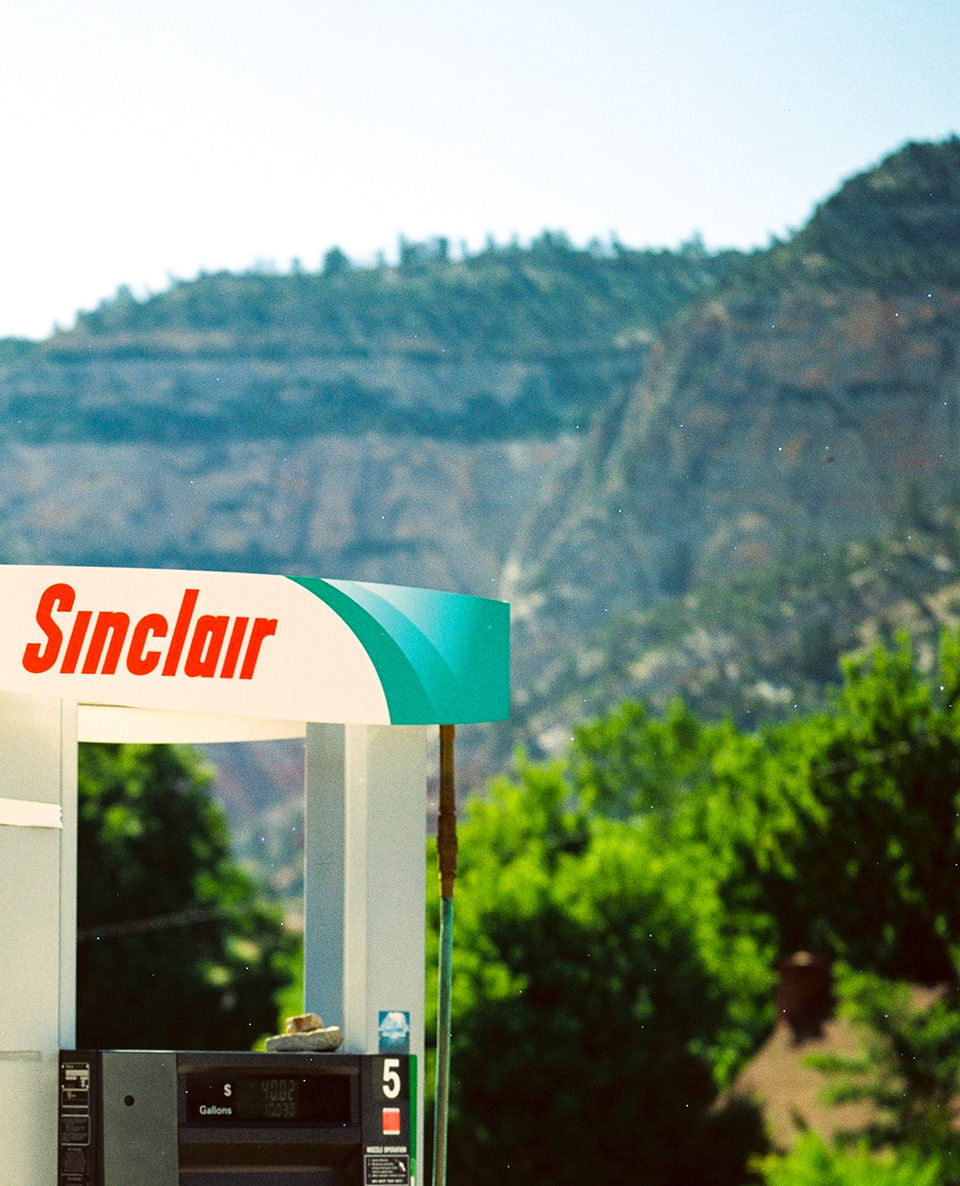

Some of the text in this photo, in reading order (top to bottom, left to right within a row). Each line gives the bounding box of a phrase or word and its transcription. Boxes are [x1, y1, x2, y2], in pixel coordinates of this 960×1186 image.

[22, 583, 279, 681] Sinclair
[223, 1083, 232, 1097] $
[382, 1058, 401, 1099] 5
[199, 1104, 232, 1115] Gallons
